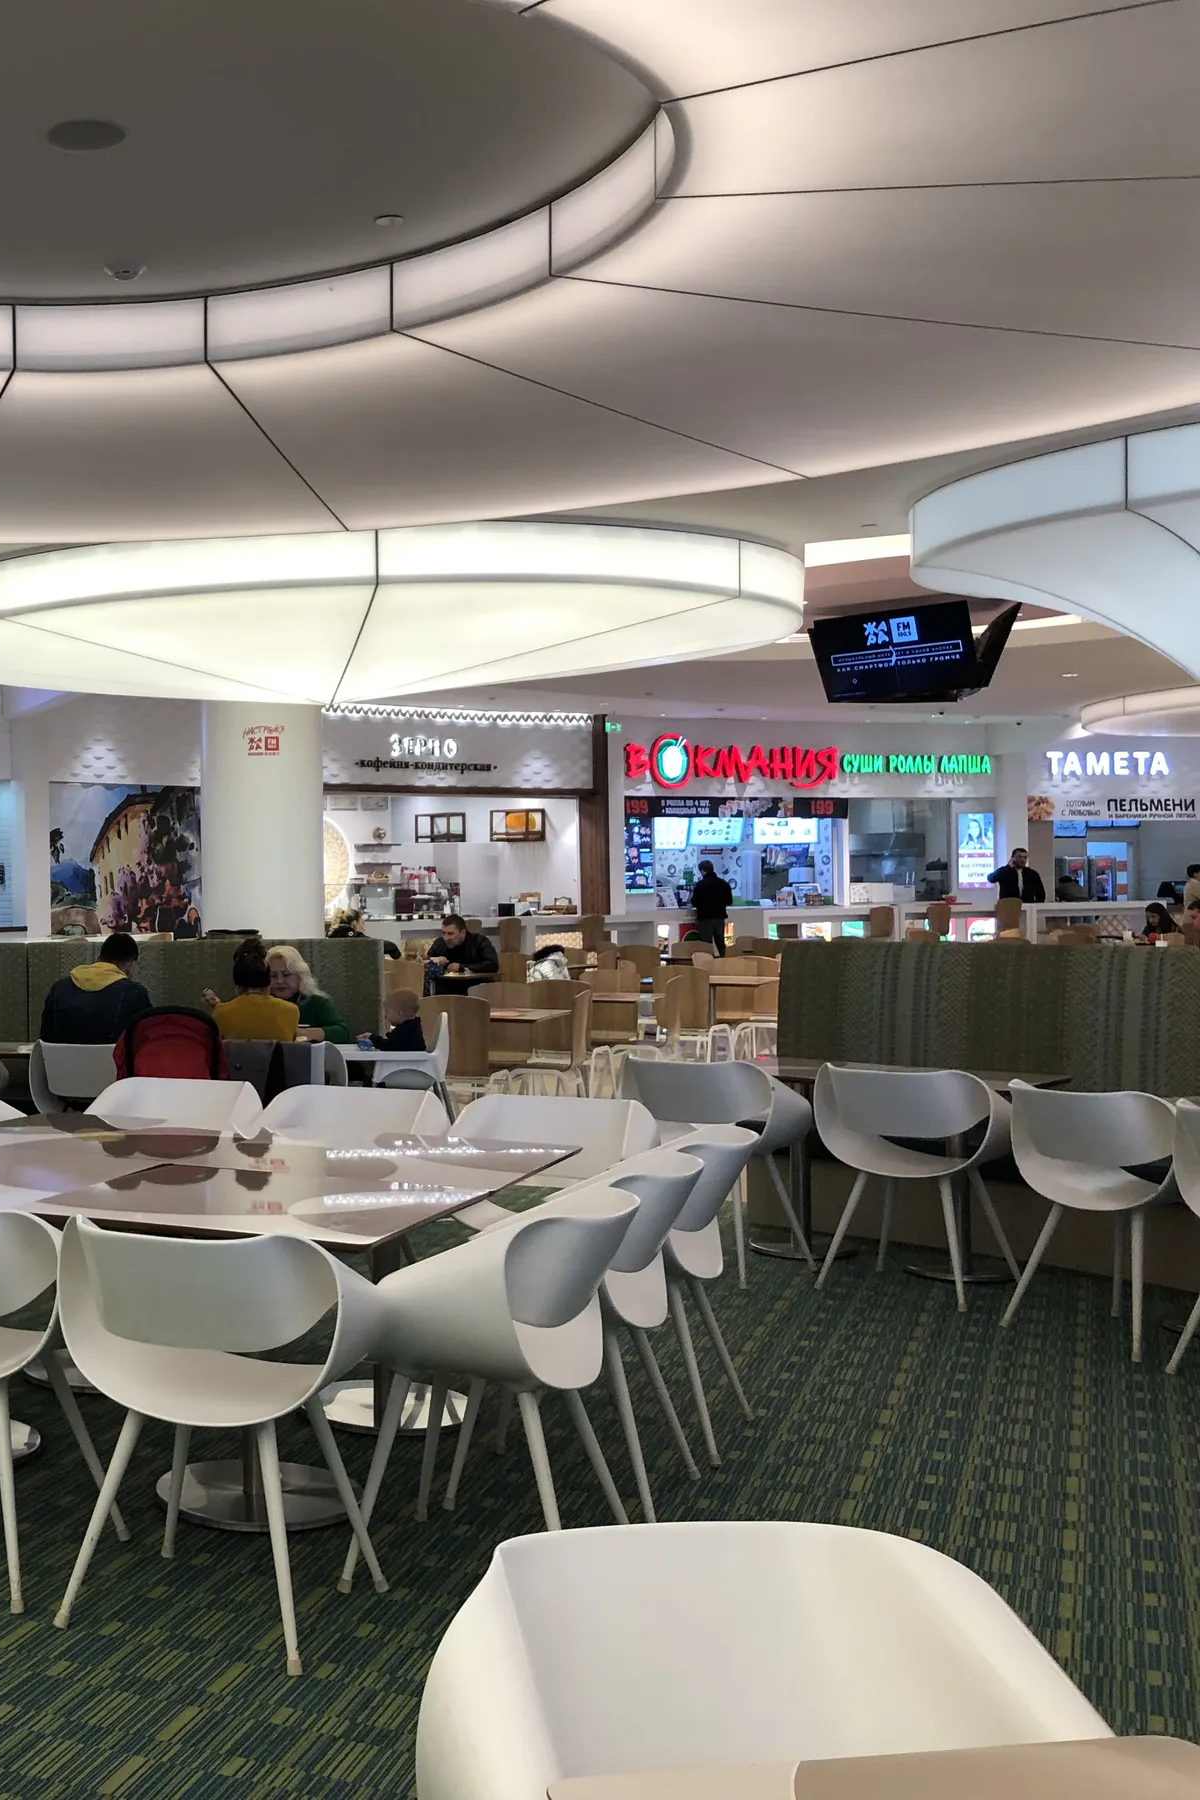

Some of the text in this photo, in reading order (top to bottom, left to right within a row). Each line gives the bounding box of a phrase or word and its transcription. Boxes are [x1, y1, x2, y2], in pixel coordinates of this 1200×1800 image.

[896, 621, 911, 631] FM
[854, 661, 896, 671] СМАРТФОН
[897, 657, 927, 666] ТОЛЬКО
[929, 653, 960, 662] ГРОМЧЕ
[389, 733, 459, 758] ЗЕРНО
[359, 757, 492, 775] кофейня-кондитерская
[624, 733, 991, 789] ВОКМАНИЯ СУШИ РОЛЛЫ ЛАПША
[1045, 750, 1170, 776] ТАМЕТА
[626, 799, 649, 814] 199
[810, 800, 834, 815] 199
[1107, 798, 1196, 812] ПЕЛЬМЕНИ
